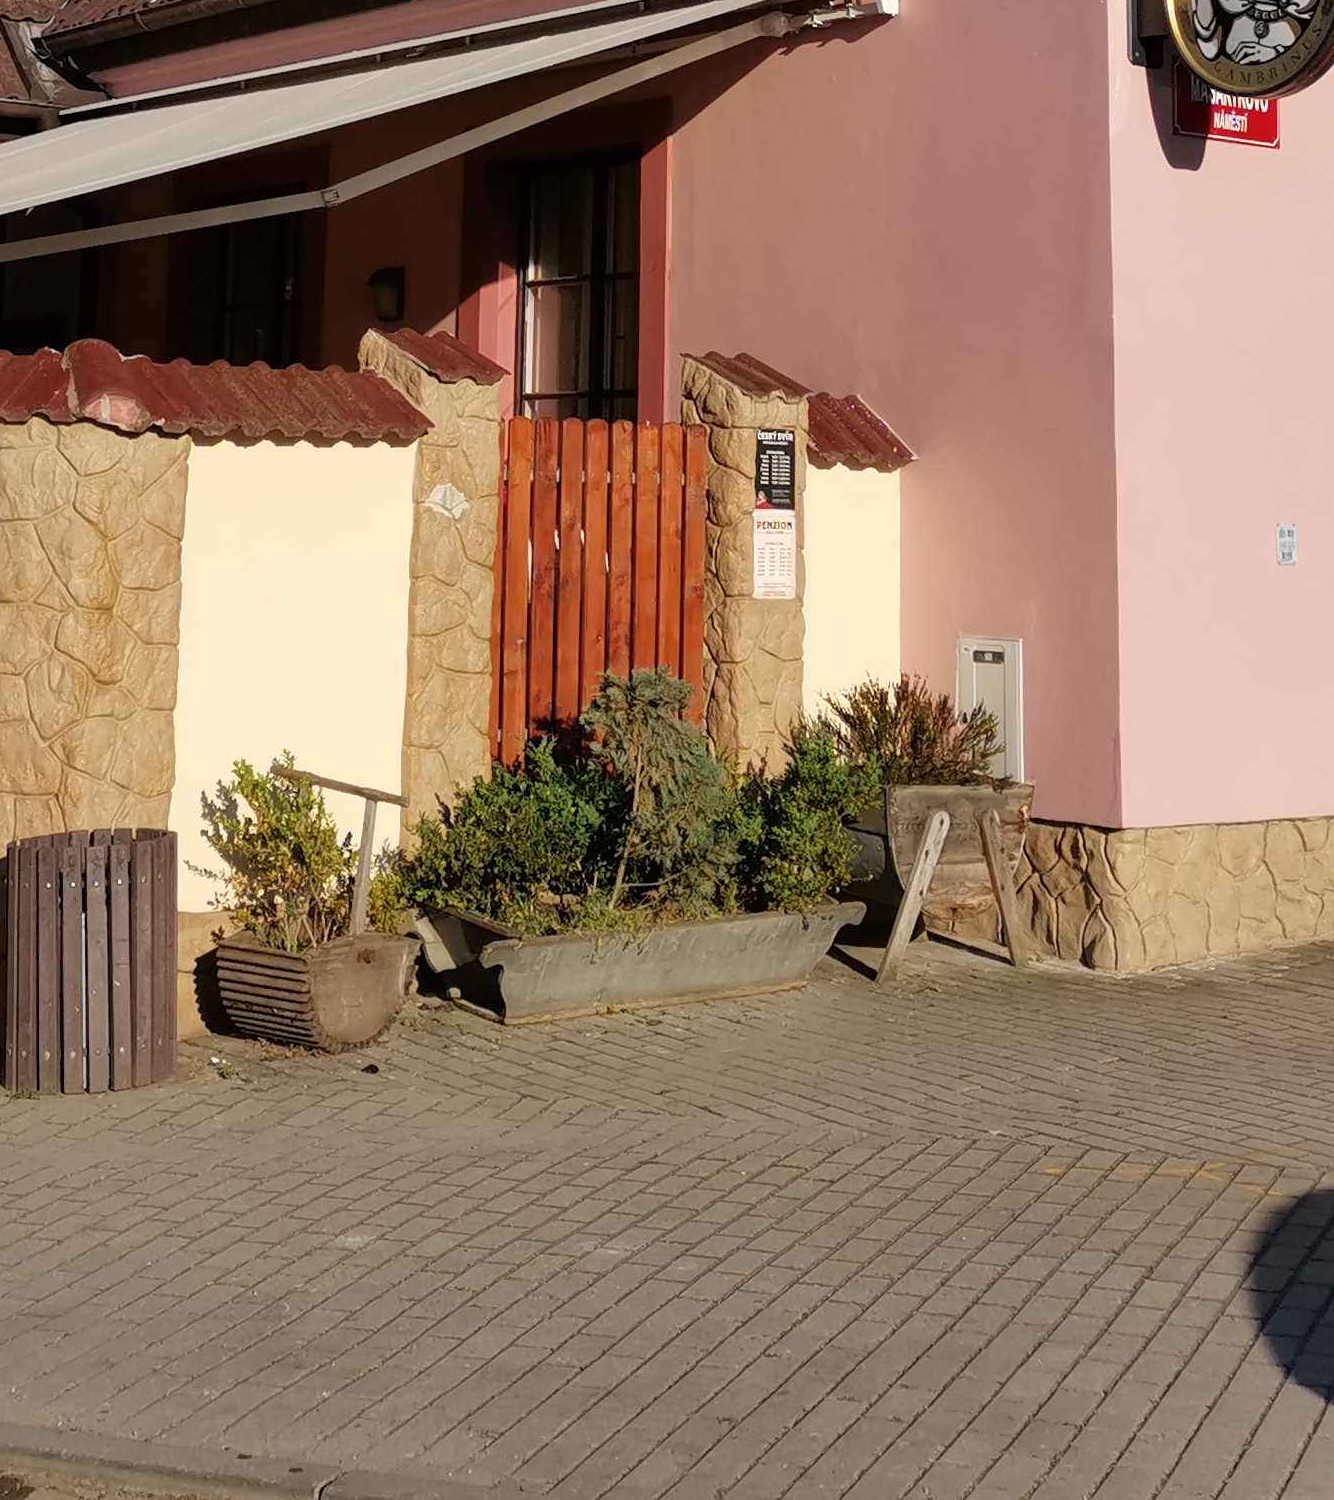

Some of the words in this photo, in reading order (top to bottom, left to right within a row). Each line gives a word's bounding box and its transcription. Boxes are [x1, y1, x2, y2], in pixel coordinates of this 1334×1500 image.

[1213, 25, 1323, 85] GAMBRINUS
[1213, 108, 1248, 132] NÁMĚSTÍ
[757, 521, 792, 530] PENZION
